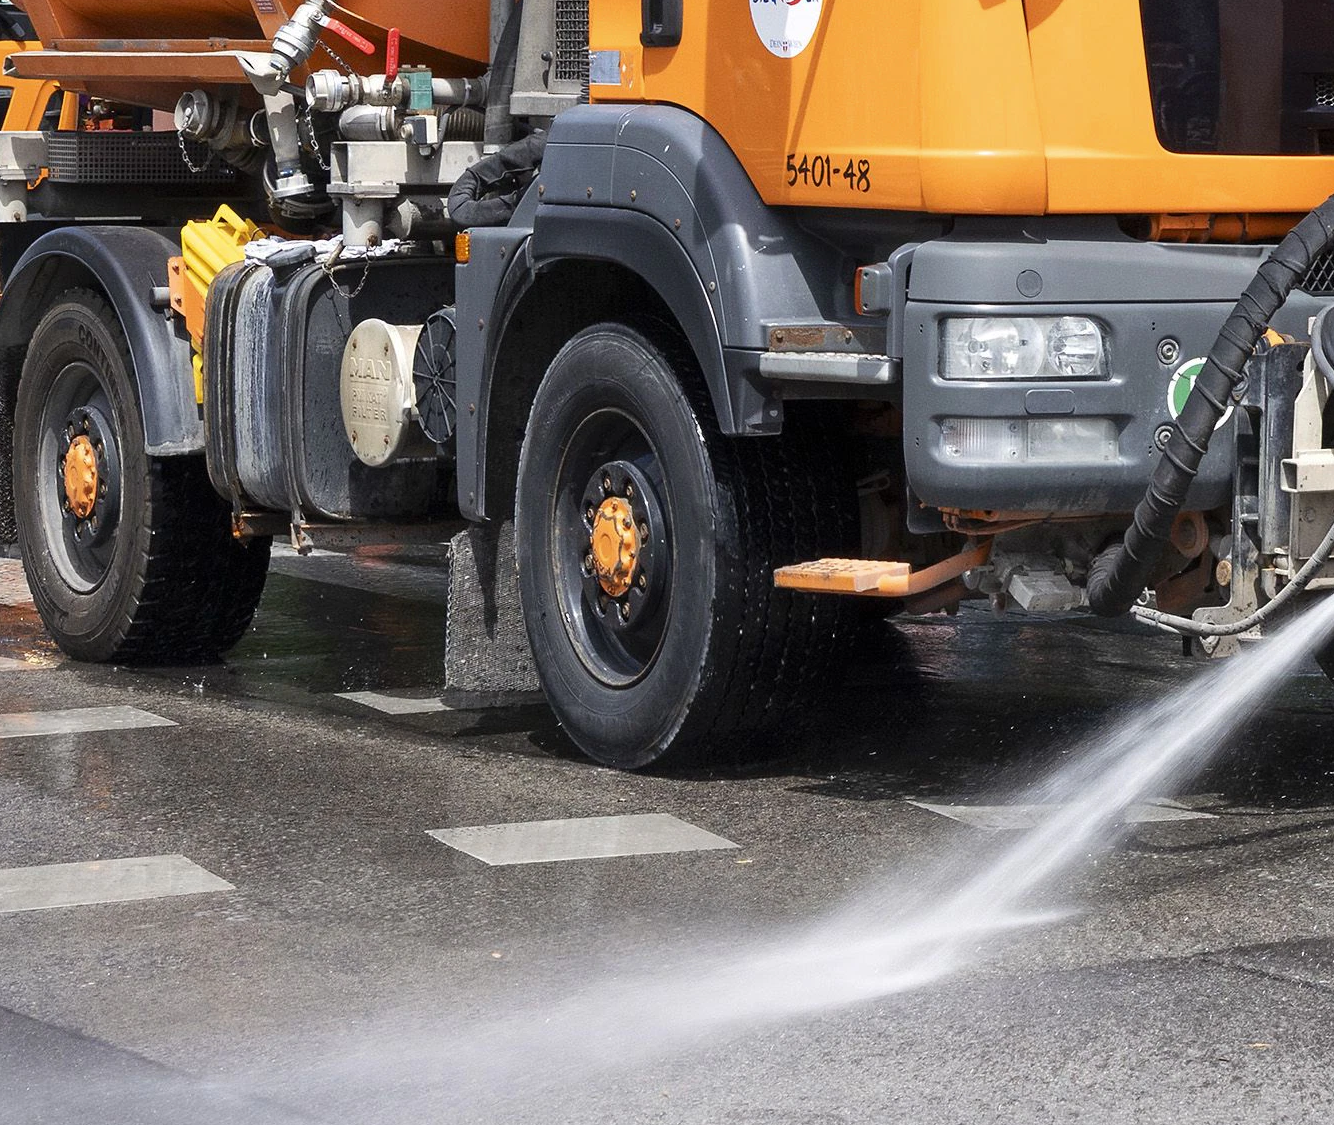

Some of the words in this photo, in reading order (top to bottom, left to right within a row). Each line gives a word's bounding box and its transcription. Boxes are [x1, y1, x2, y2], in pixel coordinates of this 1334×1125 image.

[786, 154, 871, 192] 5401-48
[350, 356, 392, 382] MAN
[352, 406, 387, 422] FILTER
